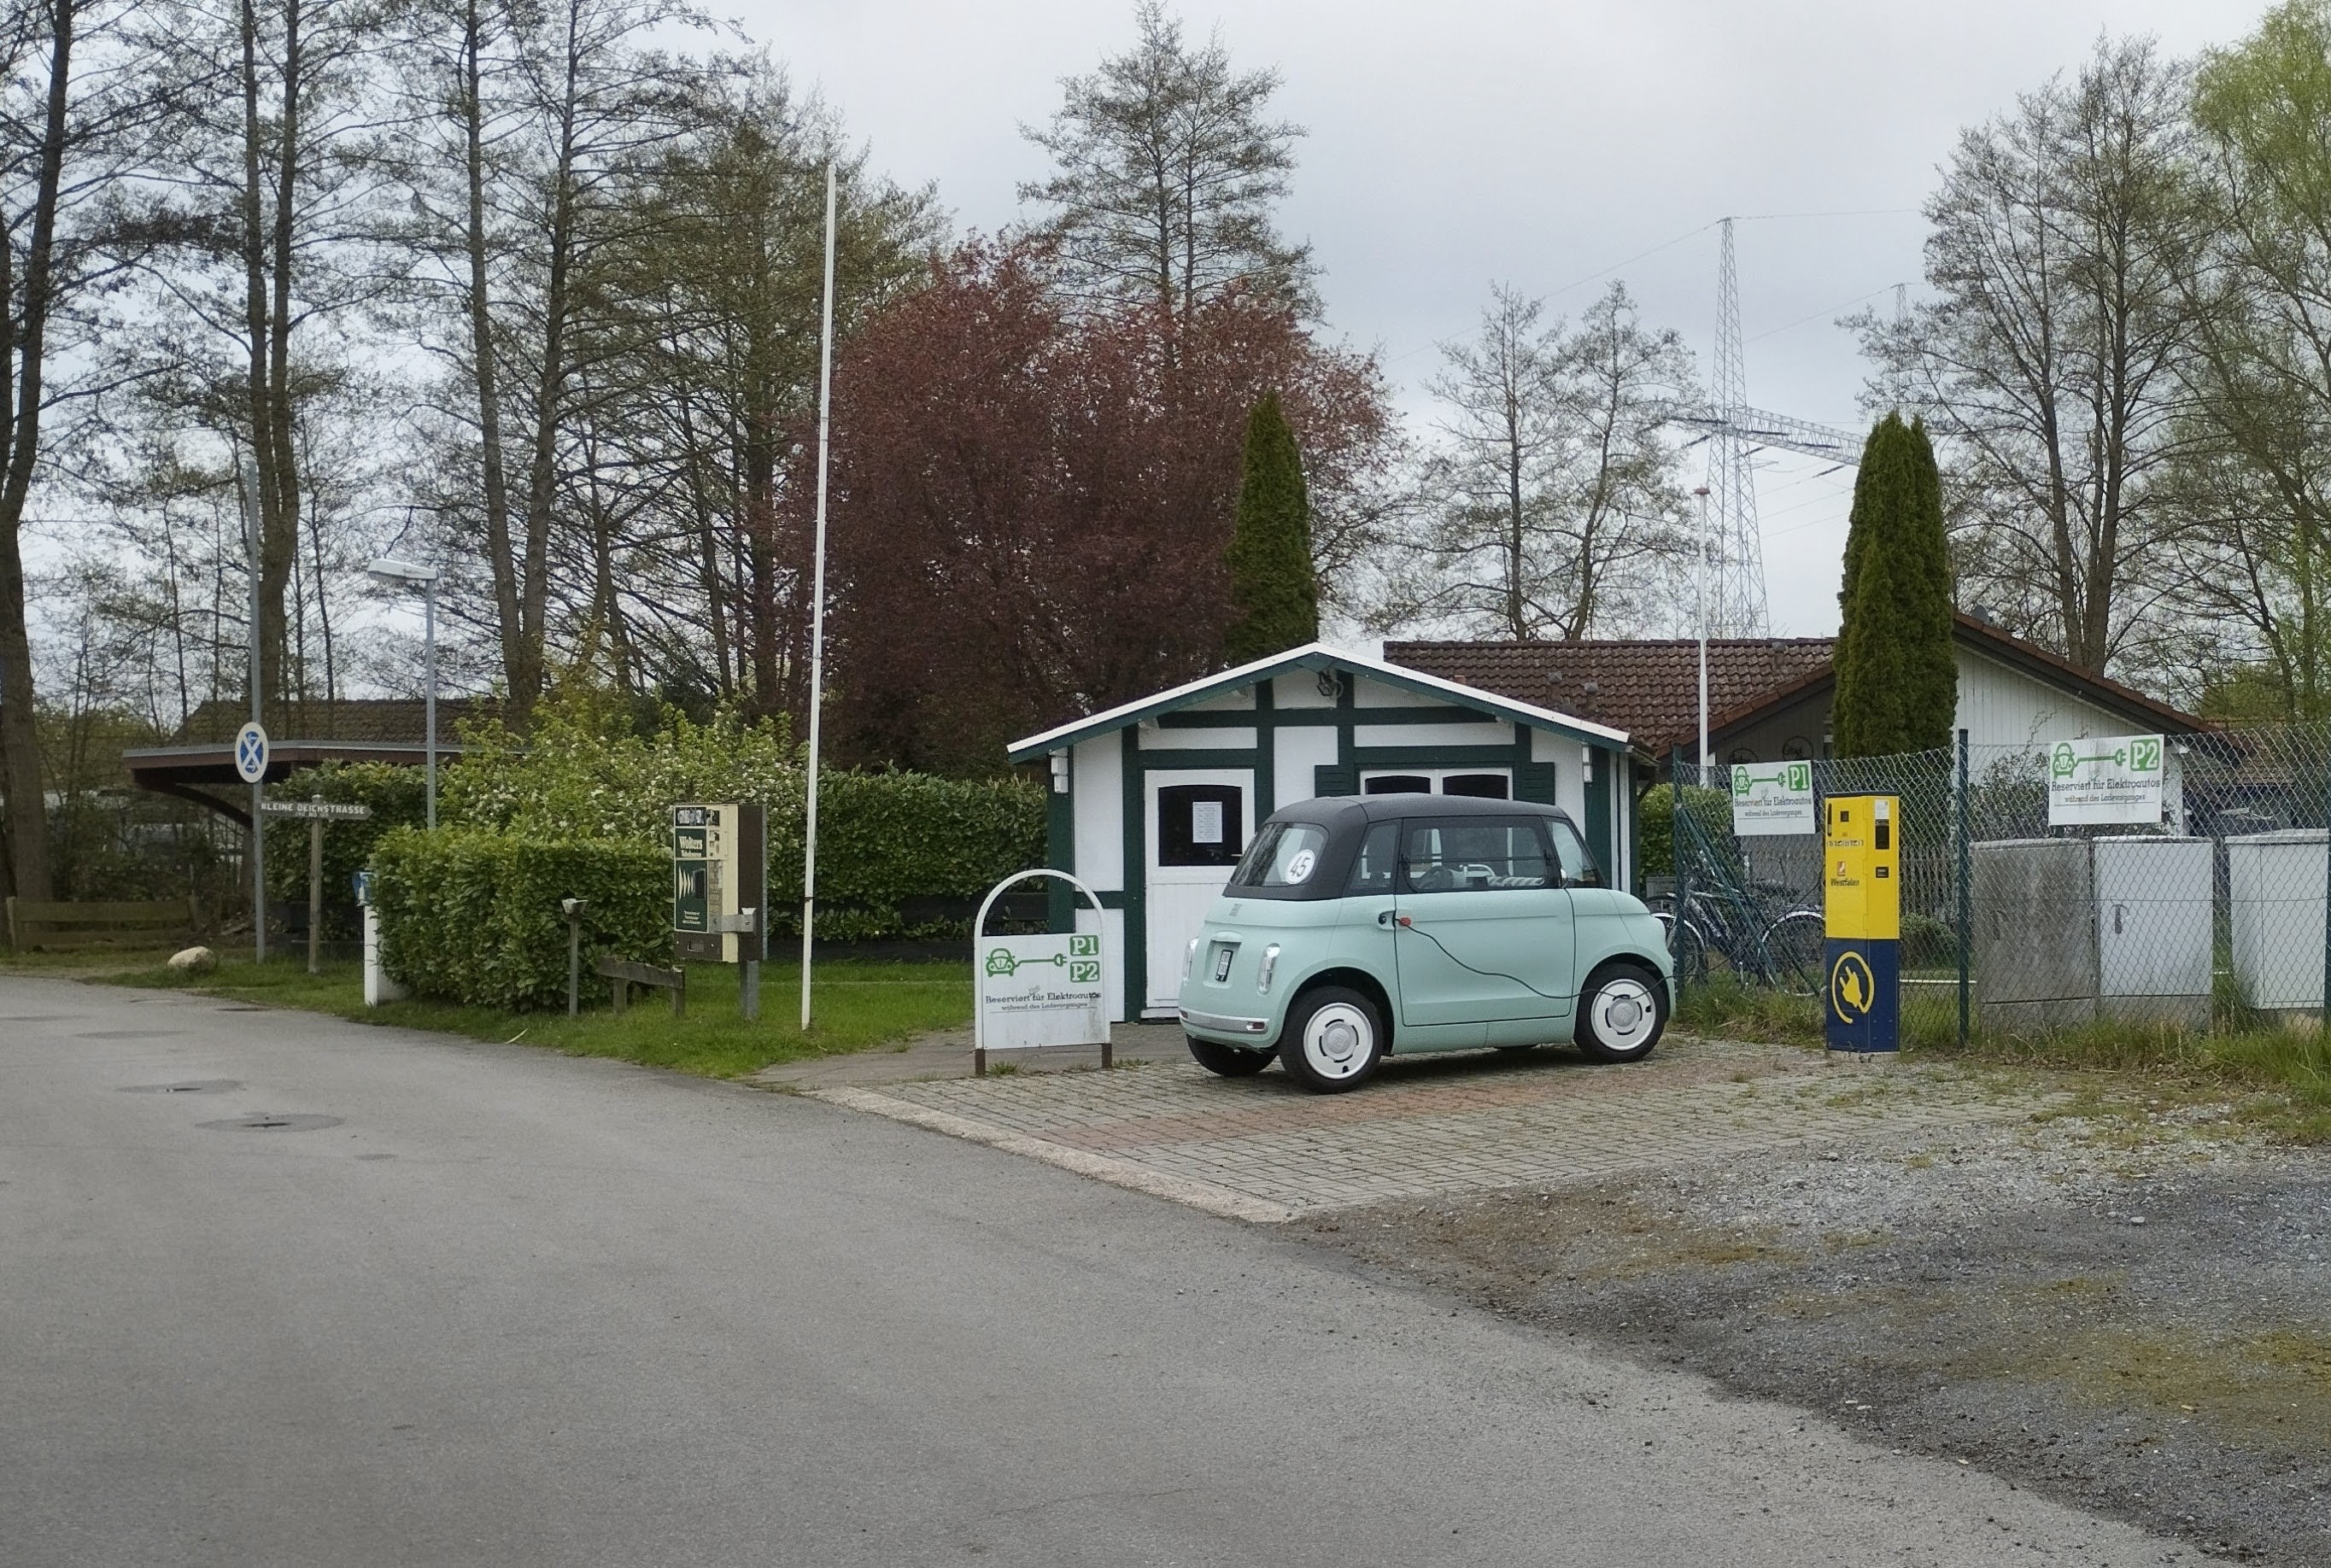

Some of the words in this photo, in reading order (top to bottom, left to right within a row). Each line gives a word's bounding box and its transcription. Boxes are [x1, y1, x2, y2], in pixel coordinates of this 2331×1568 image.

[2131, 741, 2158, 769] P2
[1789, 767, 1809, 789] P1
[2052, 781, 2090, 792] Reserviert
[2106, 777, 2160, 789] Elektroautos
[261, 802, 294, 811] KLEINE
[296, 804, 366, 815] DEICHSTRASSE
[1290, 856, 1311, 878] 45
[1071, 936, 1097, 956] P1
[1071, 962, 1098, 981] P2
[985, 994, 1030, 1003] Reserviert
[1046, 992, 1101, 1001] Elektroautos
